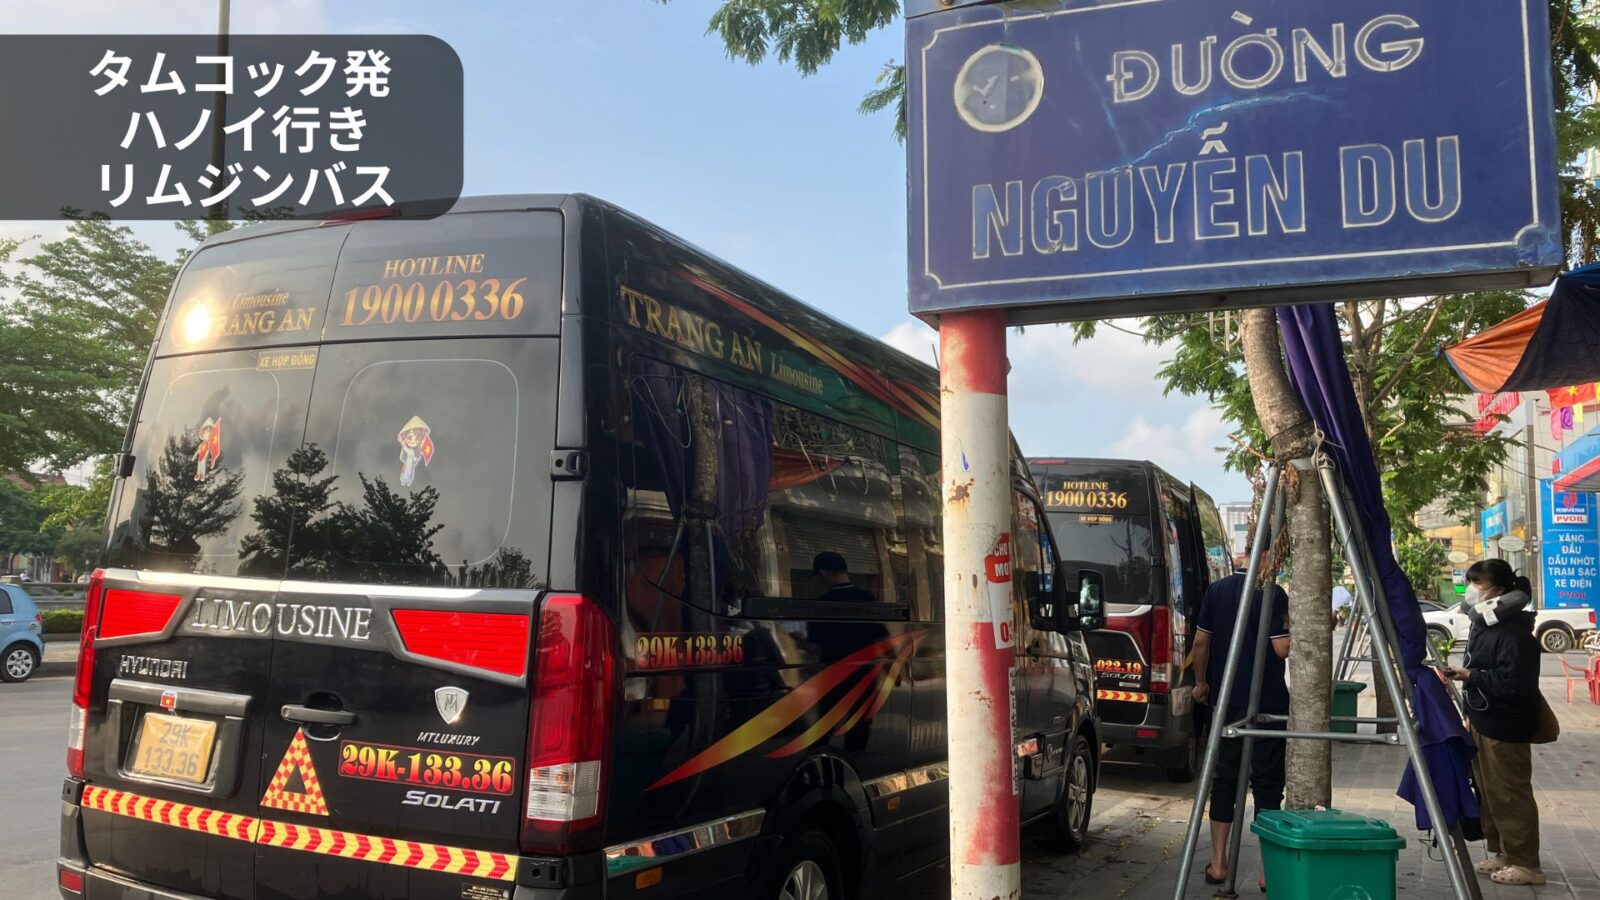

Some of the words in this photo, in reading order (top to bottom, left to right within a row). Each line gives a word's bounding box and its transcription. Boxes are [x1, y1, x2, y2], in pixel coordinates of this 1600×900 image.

[1106, 11, 1424, 103] ĐƯỜNG
[972, 122, 1305, 259] NGUYỄN
[1340, 135, 1462, 229] DU
[384, 253, 485, 279] HOTLINE
[231, 288, 290, 310] Limousine
[338, 283, 426, 327] 1900
[430, 277, 527, 322] 0336
[209, 310, 276, 337] RANG
[277, 307, 317, 332] AN
[619, 285, 725, 359] TRANG
[769, 352, 824, 396] Limousine
[1063, 481, 1109, 490] HOTLINE
[1554, 579, 1567, 588] XE
[192, 597, 372, 641] LIMOUSINE
[636, 635, 744, 668] 29K-133.36
[120, 654, 188, 679] HYUNDAI
[1095, 659, 1142, 673] 022.19
[159, 722, 192, 747] 29K
[417, 731, 481, 746] MTLUXURY
[144, 746, 200, 776] 133.36
[340, 744, 513, 792] 29K-133.36
[402, 790, 500, 814] SOLATI
